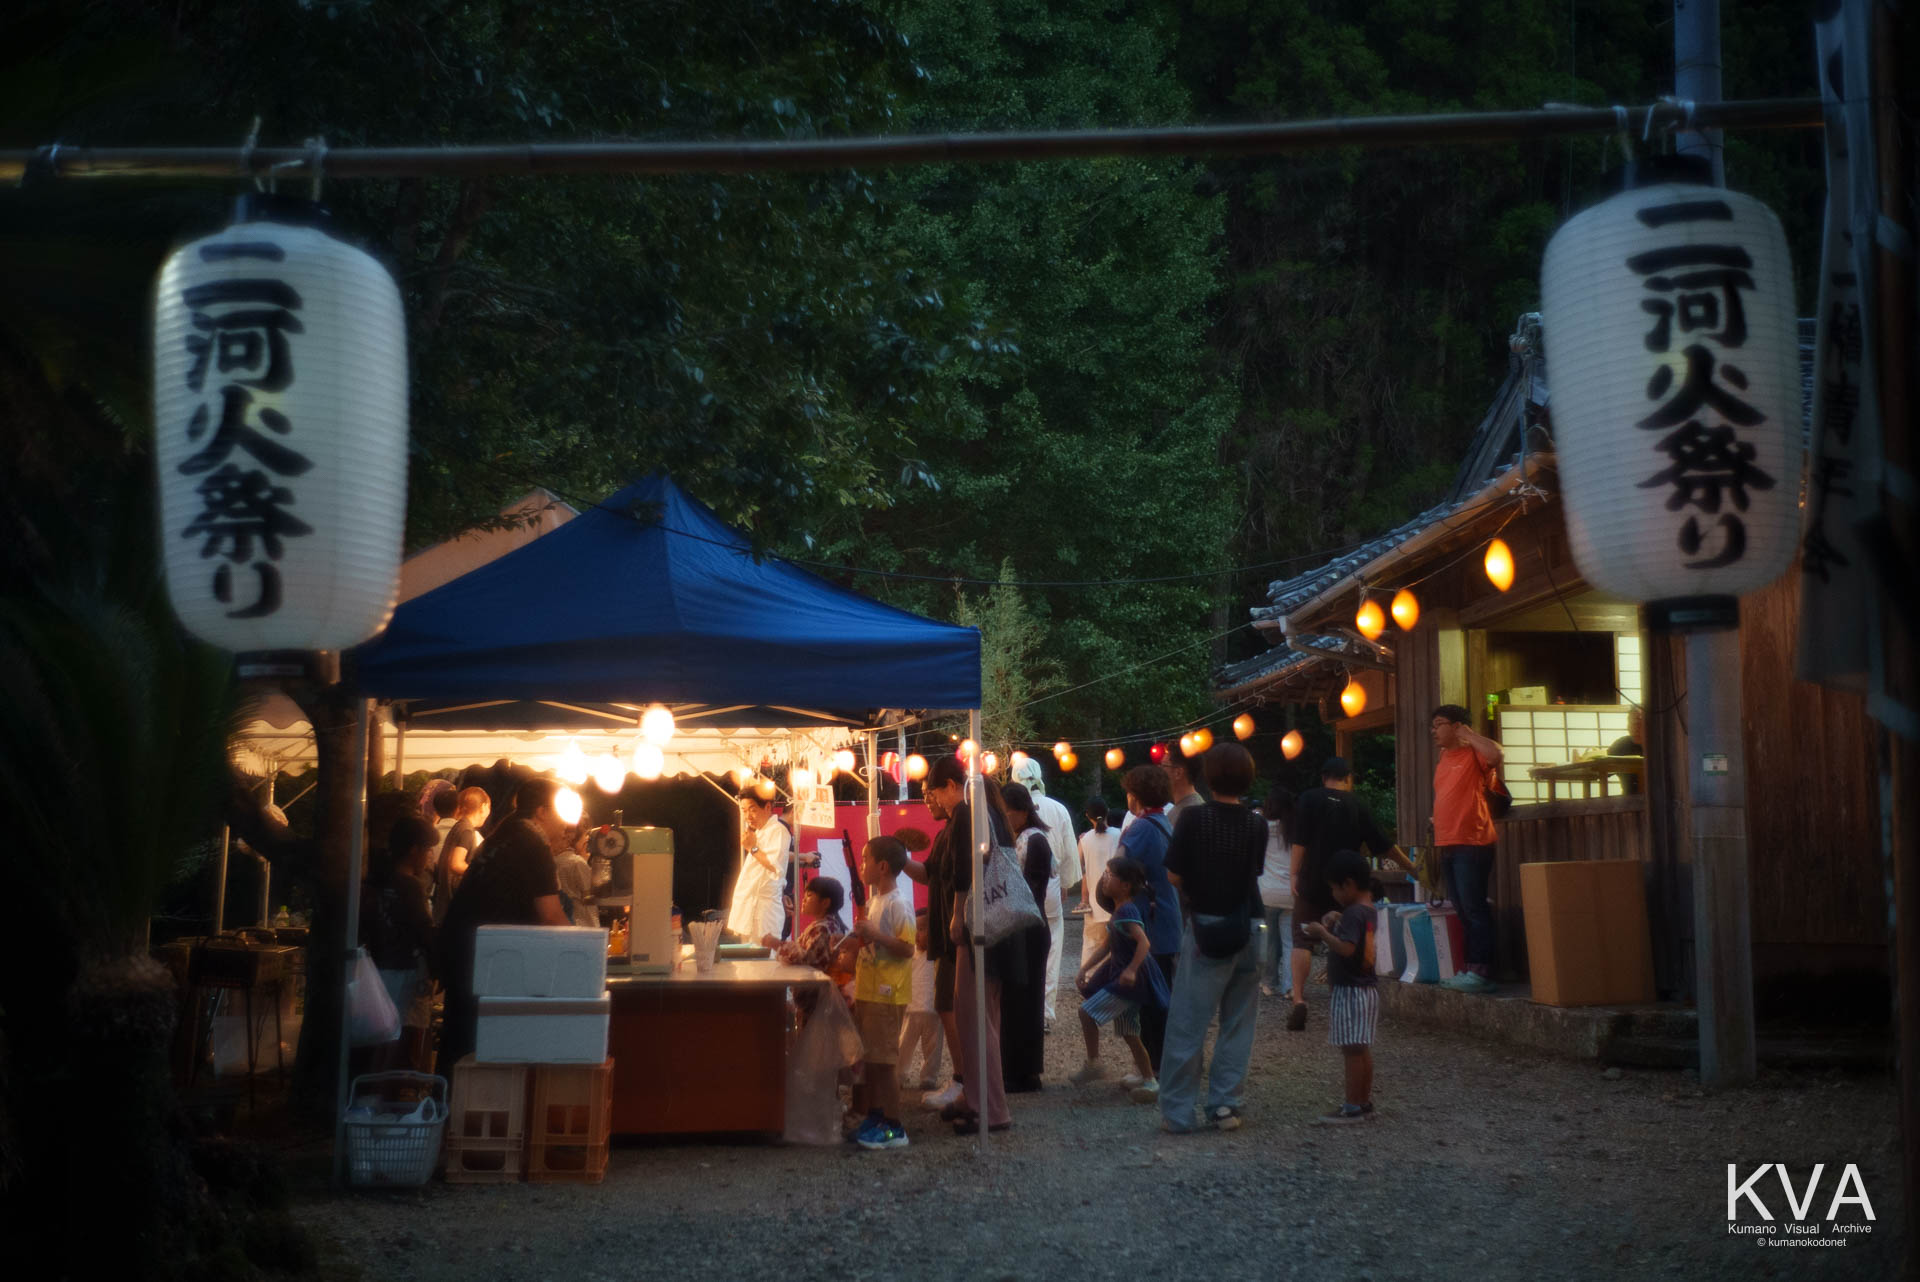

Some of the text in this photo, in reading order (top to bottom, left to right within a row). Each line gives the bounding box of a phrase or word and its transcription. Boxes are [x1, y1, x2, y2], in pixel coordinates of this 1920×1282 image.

[177, 241, 315, 619] 二河火祭り
[1626, 200, 1777, 570] 二河火祭り
